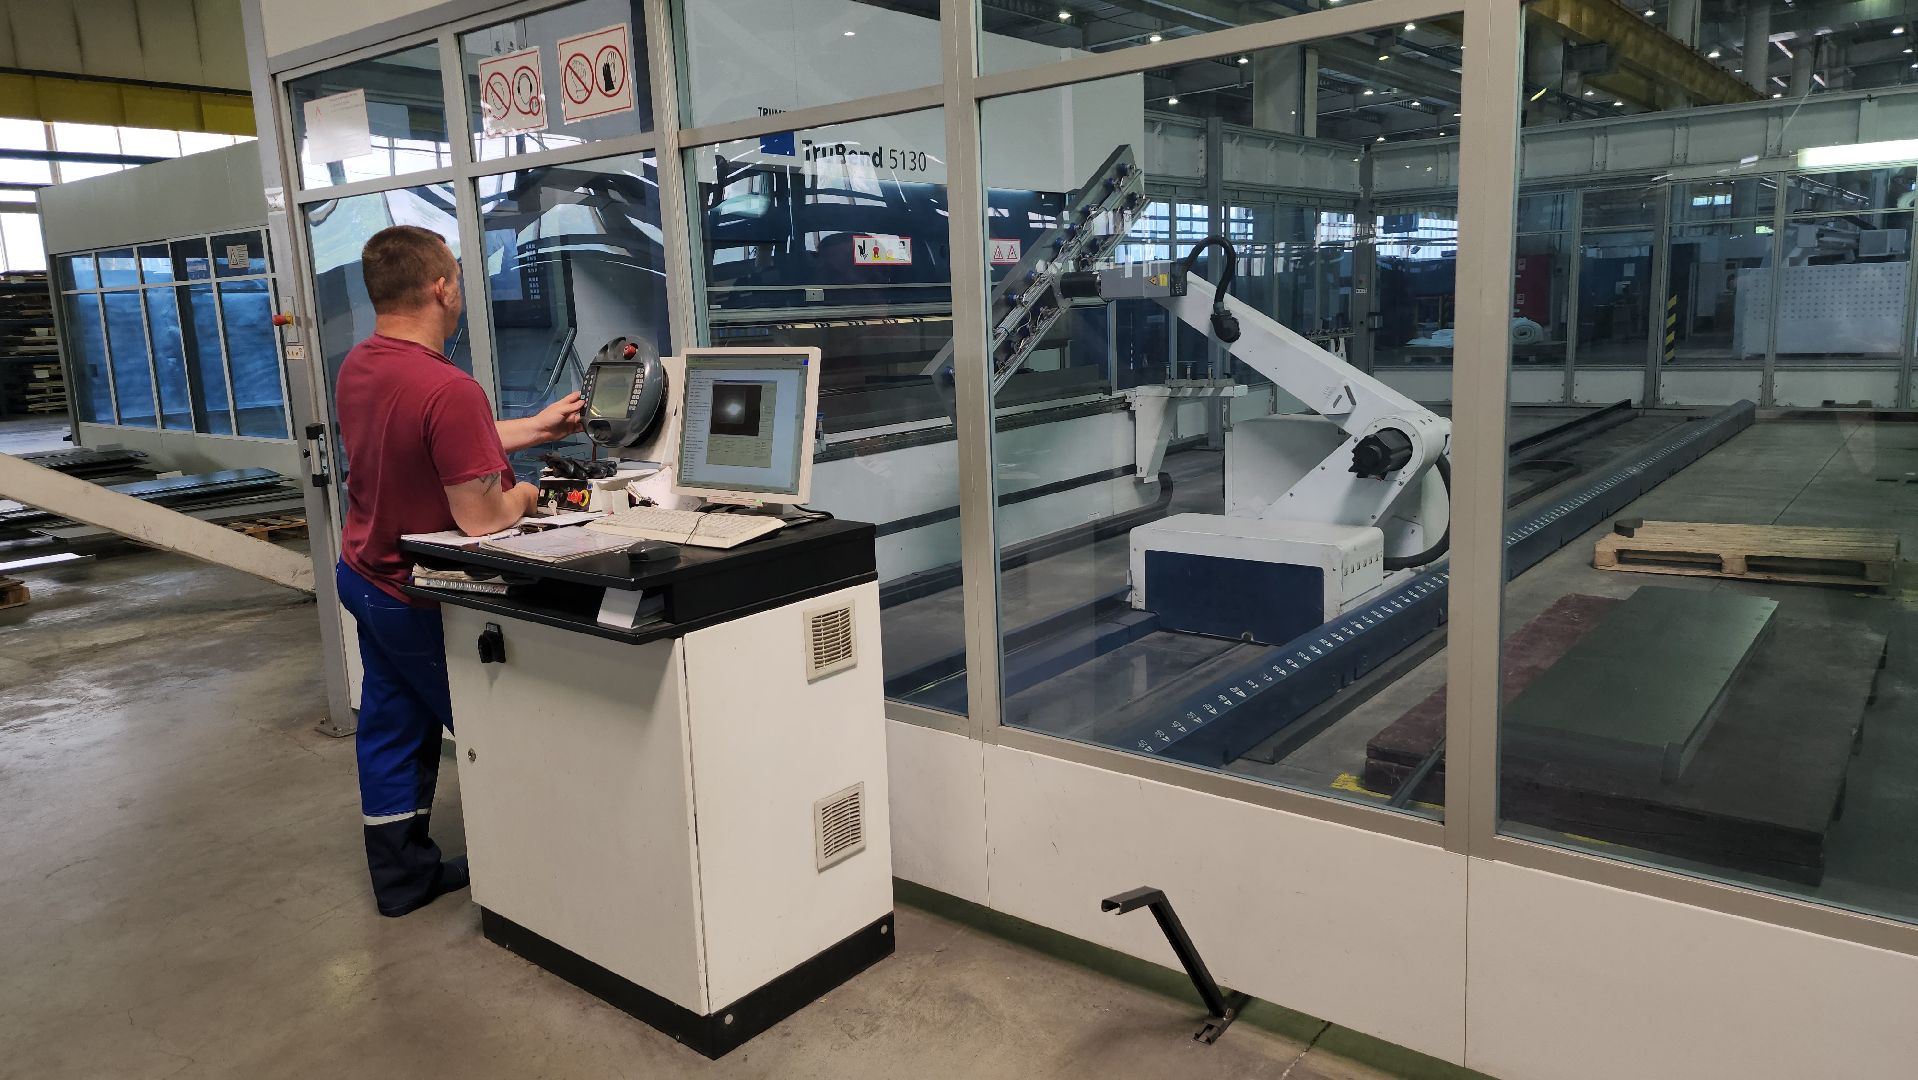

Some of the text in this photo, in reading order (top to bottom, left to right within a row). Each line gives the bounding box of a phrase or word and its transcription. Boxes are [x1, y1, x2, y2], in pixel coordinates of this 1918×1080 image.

[757, 106, 787, 117] TRU
[801, 139, 927, 172] TruBd 5130
